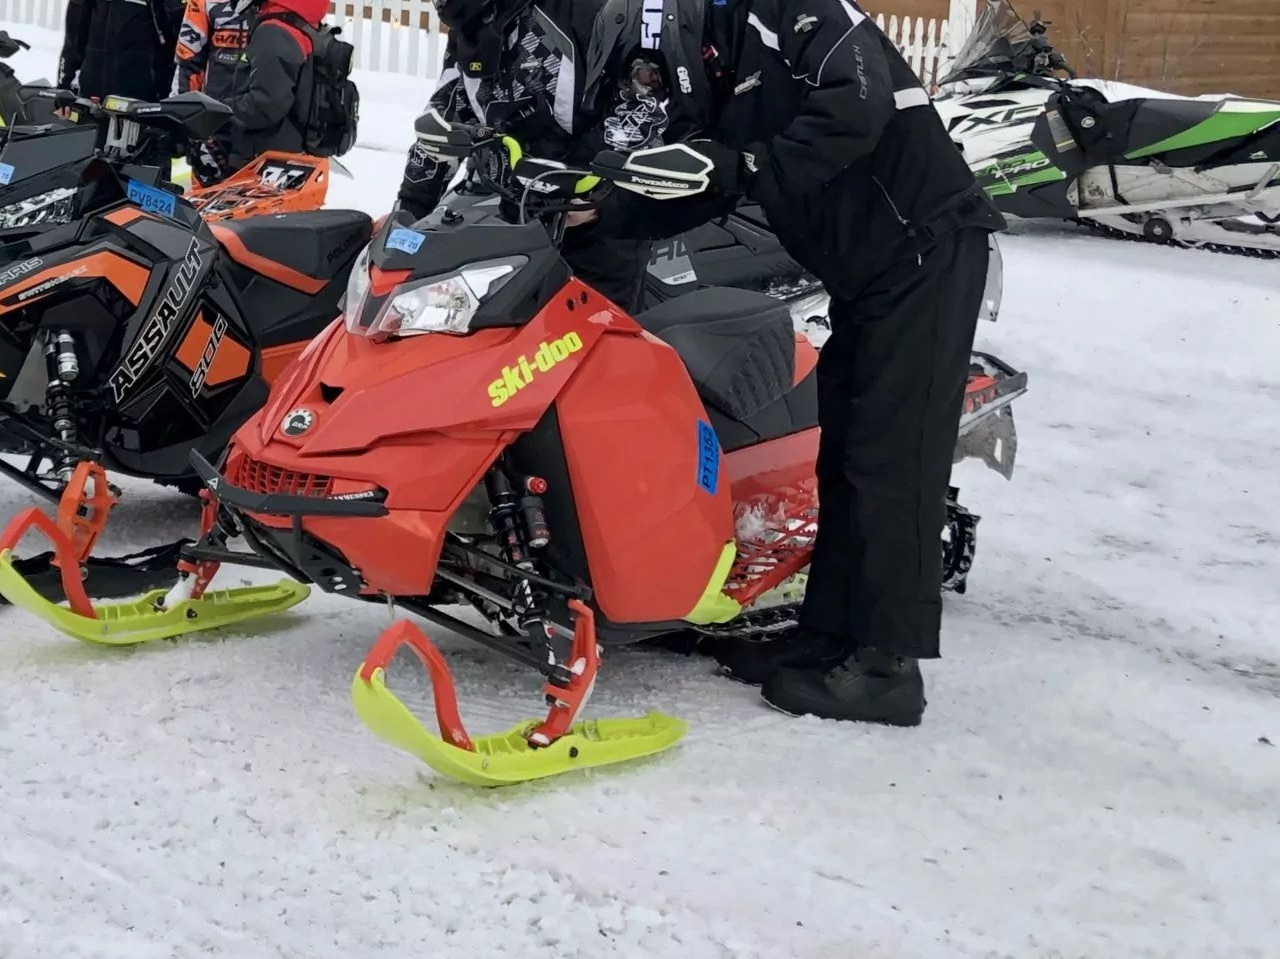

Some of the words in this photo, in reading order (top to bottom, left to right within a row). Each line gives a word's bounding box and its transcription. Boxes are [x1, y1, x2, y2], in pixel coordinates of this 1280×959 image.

[129, 189, 172, 214] PV8424
[108, 235, 203, 404] ASSAULT
[487, 331, 583, 408] ski-doo
